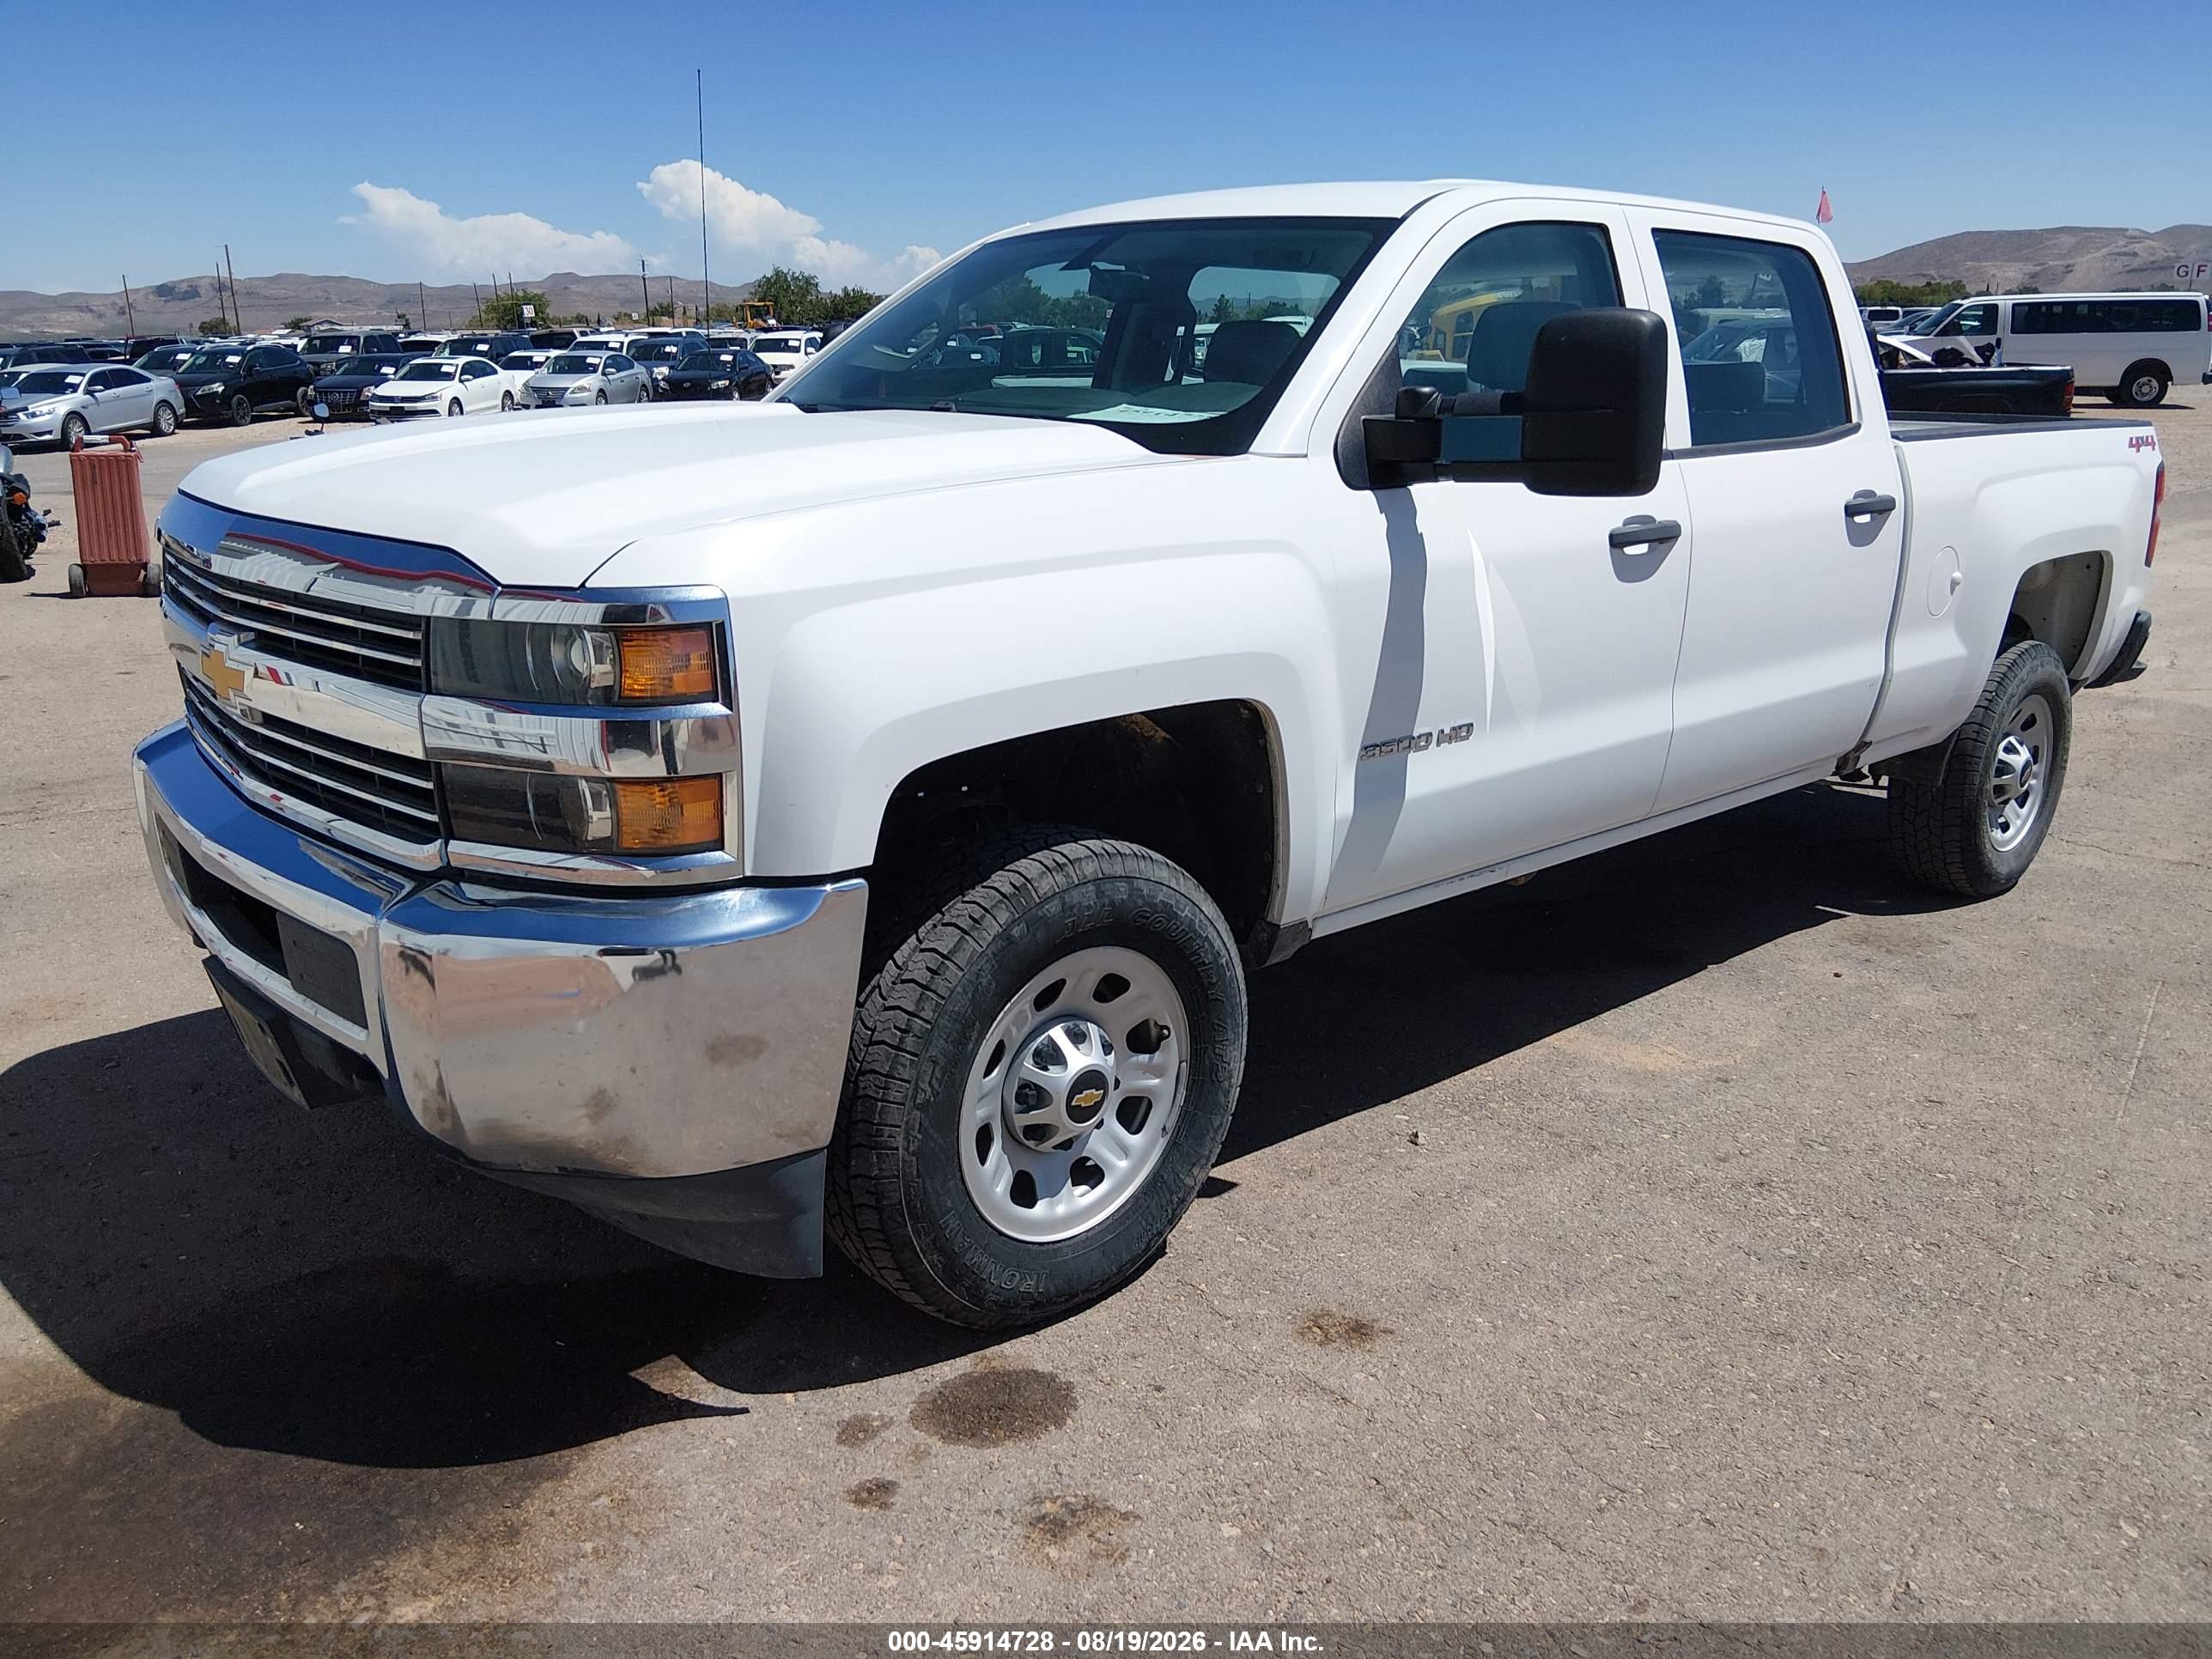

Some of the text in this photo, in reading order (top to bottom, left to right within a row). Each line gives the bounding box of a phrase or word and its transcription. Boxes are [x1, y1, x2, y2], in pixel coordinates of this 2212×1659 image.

[2176, 264, 2189, 278] G
[2197, 264, 2208, 278] F
[524, 306, 533, 316] 30
[1436, 722, 1474, 747] HD
[1128, 907, 1225, 1004] COUNTRY
[939, 1211, 1050, 1292] IRONMAN
